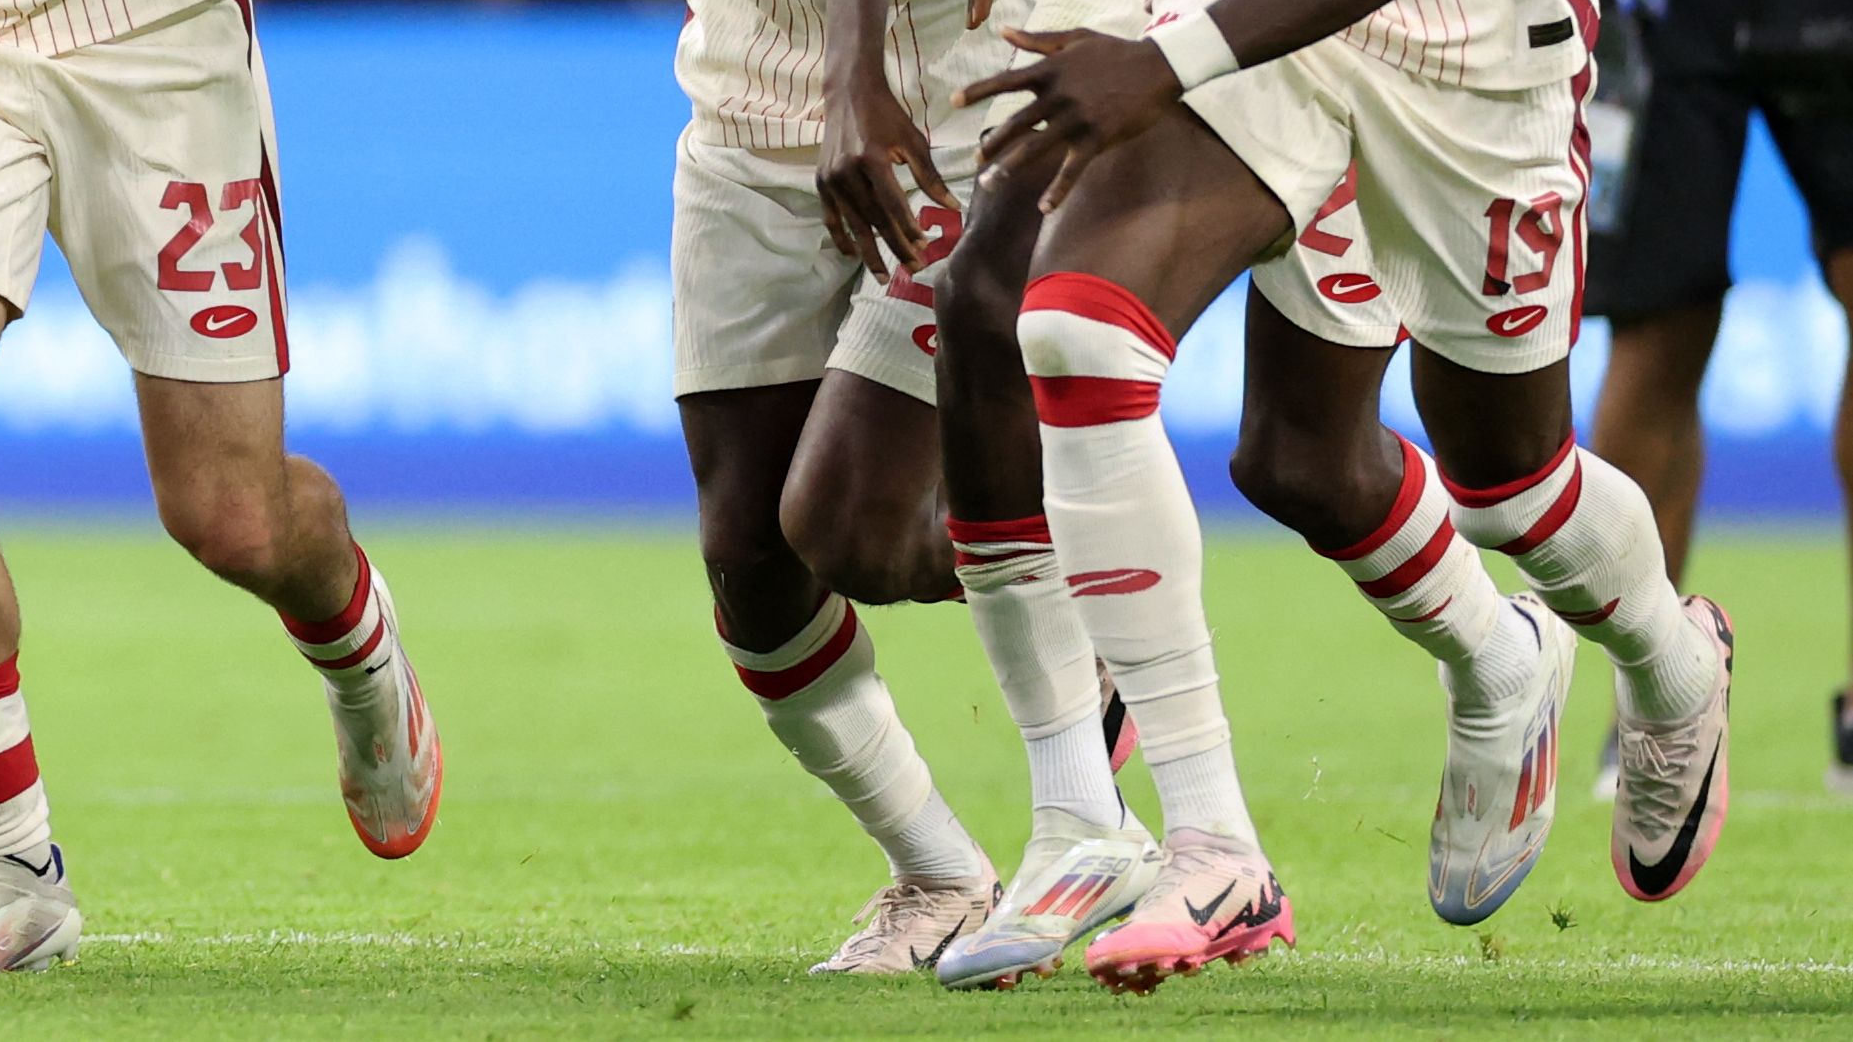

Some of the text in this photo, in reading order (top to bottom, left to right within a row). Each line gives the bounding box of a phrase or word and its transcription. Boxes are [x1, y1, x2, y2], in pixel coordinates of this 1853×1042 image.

[157, 177, 263, 292] 23
[1482, 190, 1564, 296] 19
[1068, 855, 1132, 874] F50
